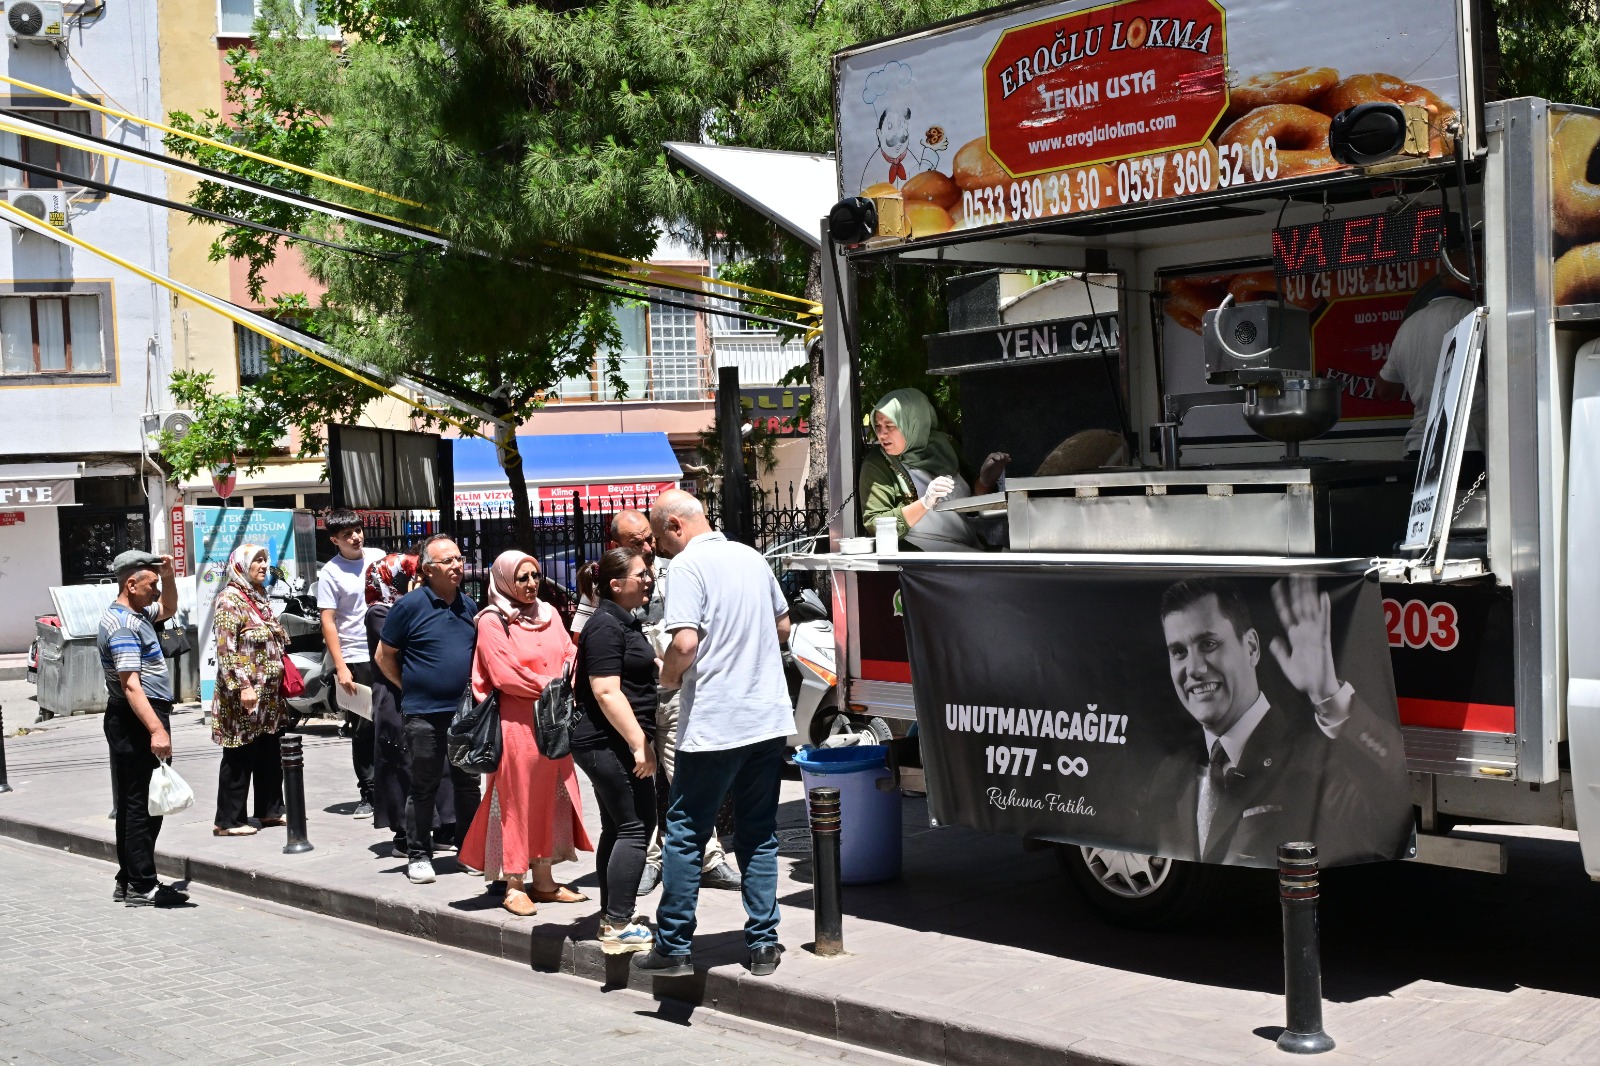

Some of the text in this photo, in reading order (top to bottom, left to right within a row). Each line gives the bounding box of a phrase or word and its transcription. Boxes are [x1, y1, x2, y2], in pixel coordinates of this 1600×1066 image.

[999, 16, 1213, 99] EROĞLU LOKMA
[1105, 69, 1156, 99] USTA
[1028, 114, 1177, 154] www.eroglulokma.com
[963, 185, 1006, 228] 0533
[1010, 178, 1044, 221] 930
[1049, 173, 1071, 215] 33
[1076, 168, 1100, 210] 30
[1117, 156, 1167, 204] 0537
[1172, 148, 1211, 195] 360
[1218, 142, 1245, 187] 52
[1251, 135, 1279, 182] 03
[1339, 217, 1396, 264] EL
[454, 491, 481, 501] KLİM
[607, 485, 634, 493] Beyaz
[221, 513, 266, 524] TEKSTİL
[1382, 598, 1459, 651] 203
[945, 703, 1129, 745] UNUTMAYACAĞIZ!
[985, 745, 1038, 777] 1977
[986, 786, 1097, 816] Ruhuna Fatiha
